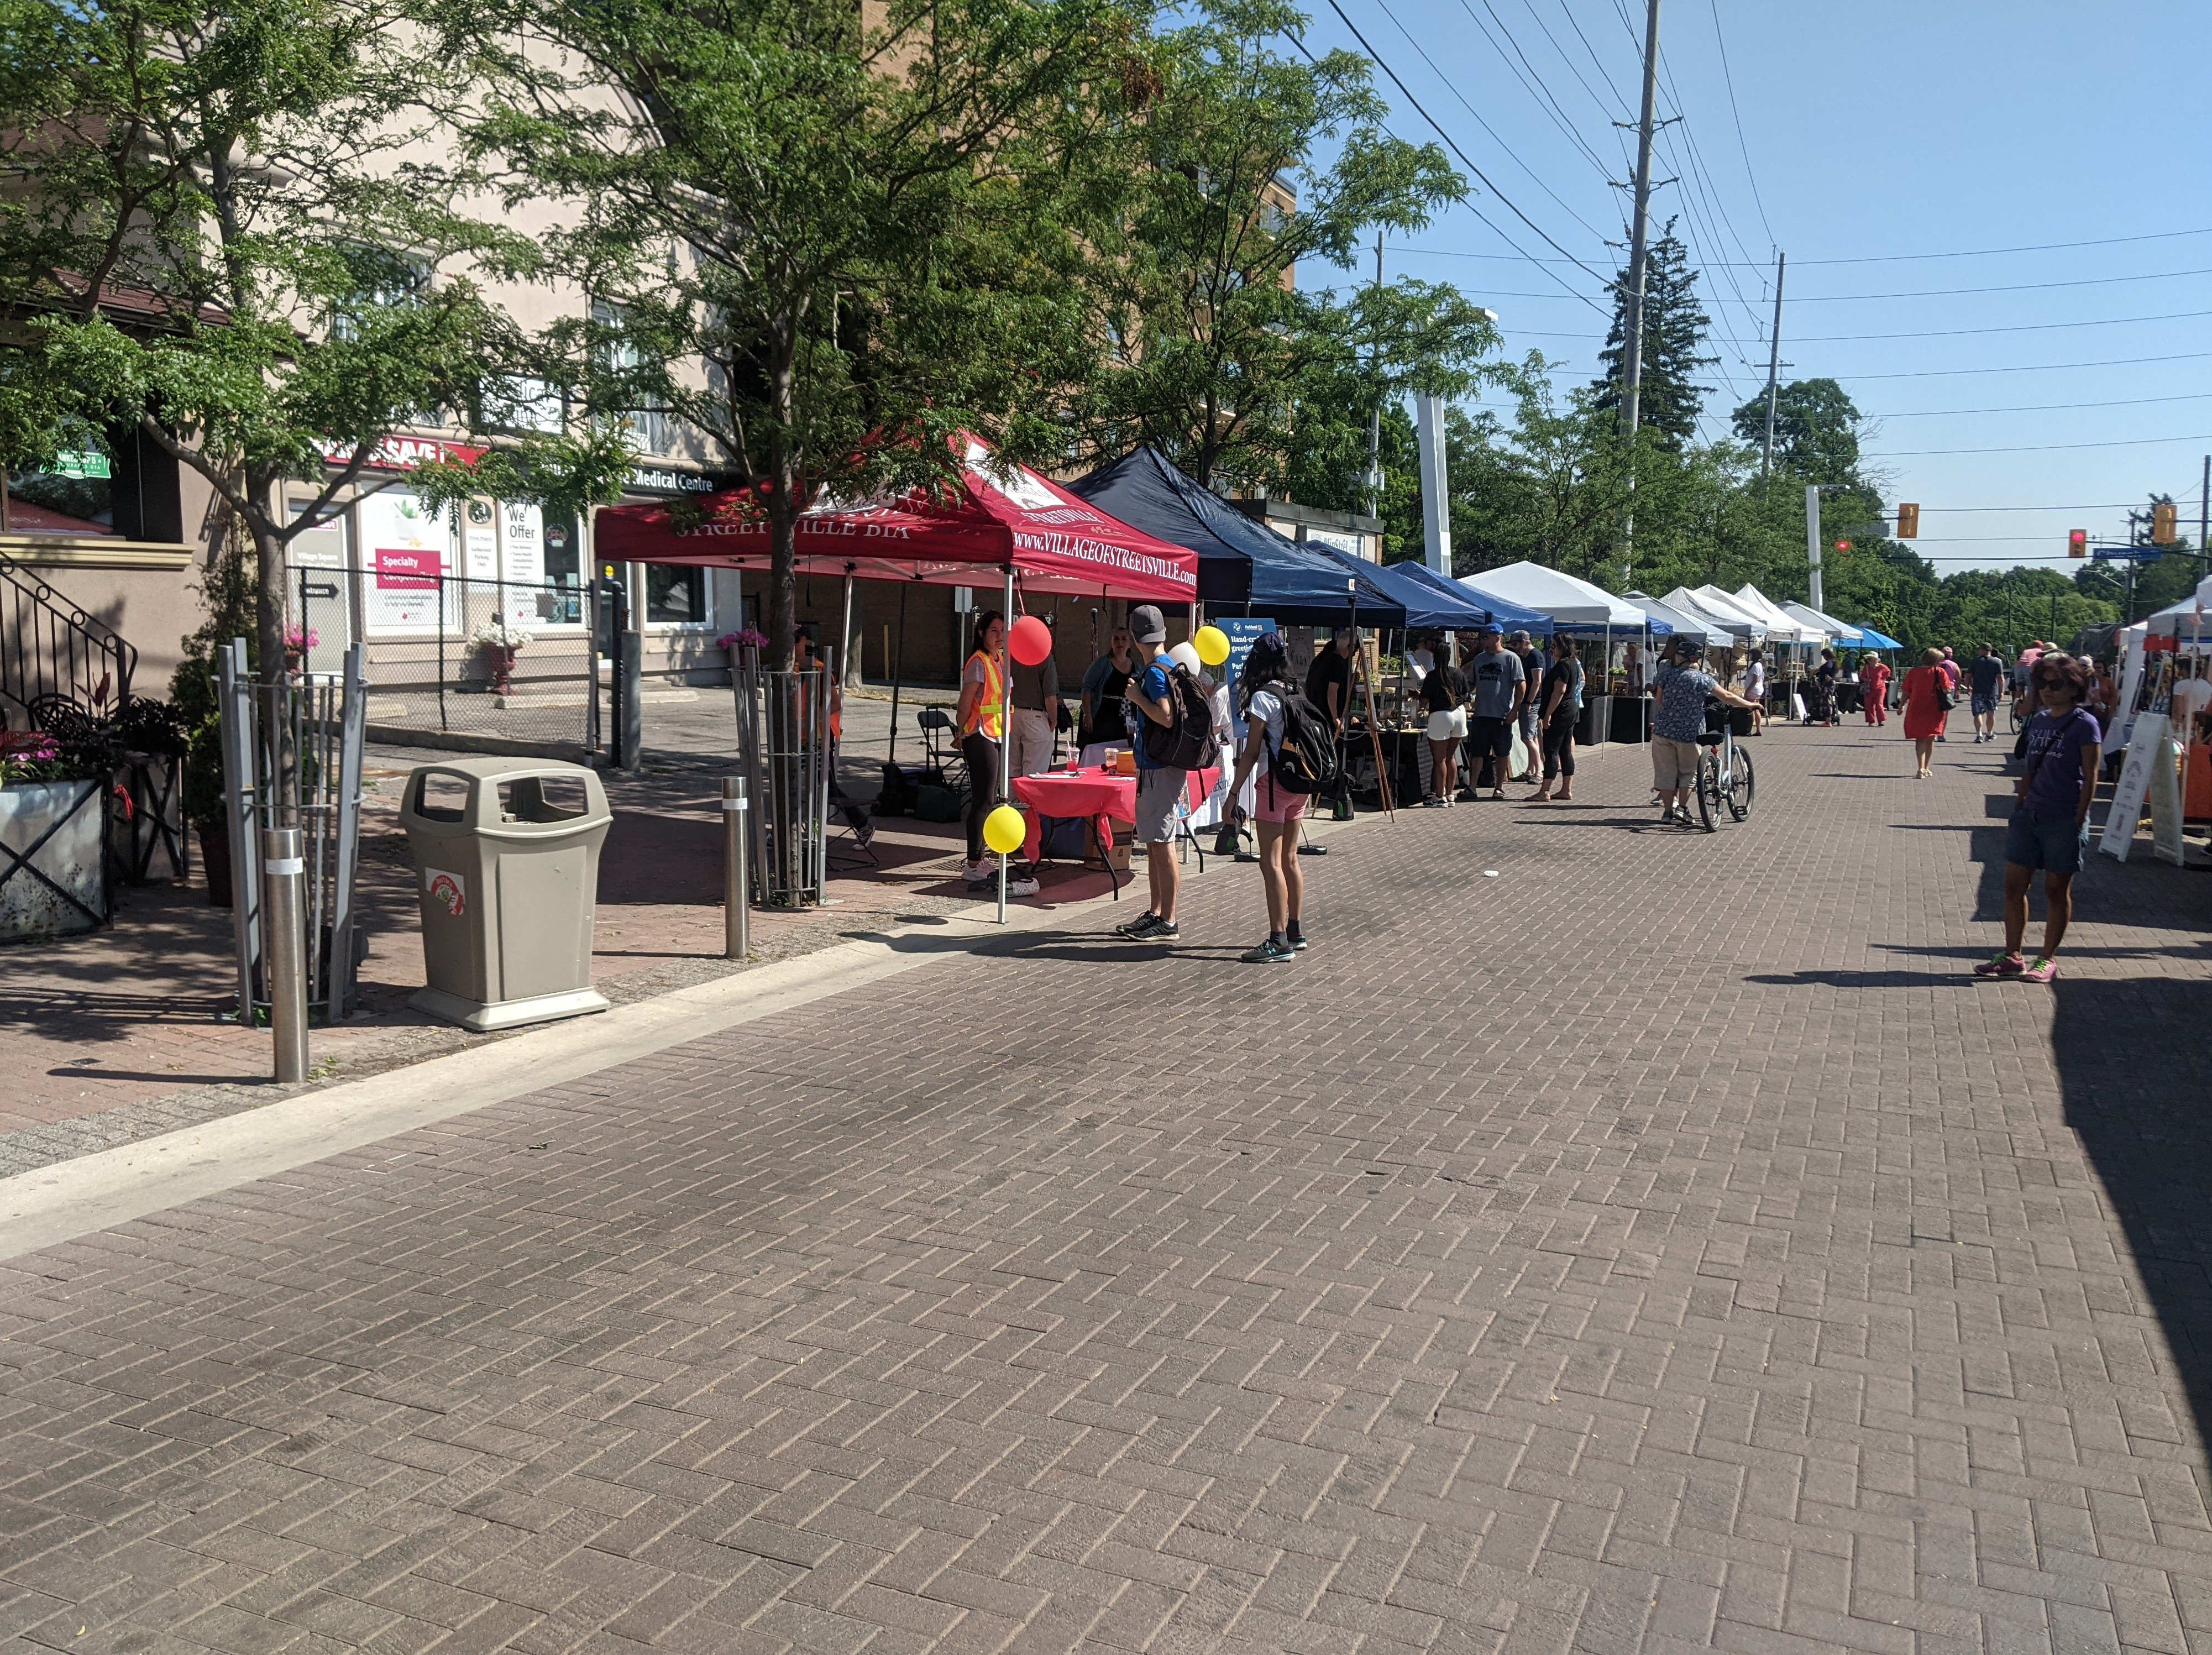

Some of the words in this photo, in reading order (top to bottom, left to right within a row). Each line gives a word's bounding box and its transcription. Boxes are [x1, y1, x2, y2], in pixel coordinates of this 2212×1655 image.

[633, 469, 677, 489] Medical
[678, 474, 713, 491] Centre
[509, 507, 525, 522] We
[1020, 509, 1104, 524] STREETSVILLE
[510, 525, 535, 539] Offer
[675, 520, 856, 538] TREETILLE
[297, 552, 317, 561] Village
[318, 553, 338, 562] Square
[382, 556, 418, 569] Specialty
[1013, 532, 1197, 586] www.VILLAGEOFSTREETSVILLE.com
[1211, 774, 1231, 793] arkland
